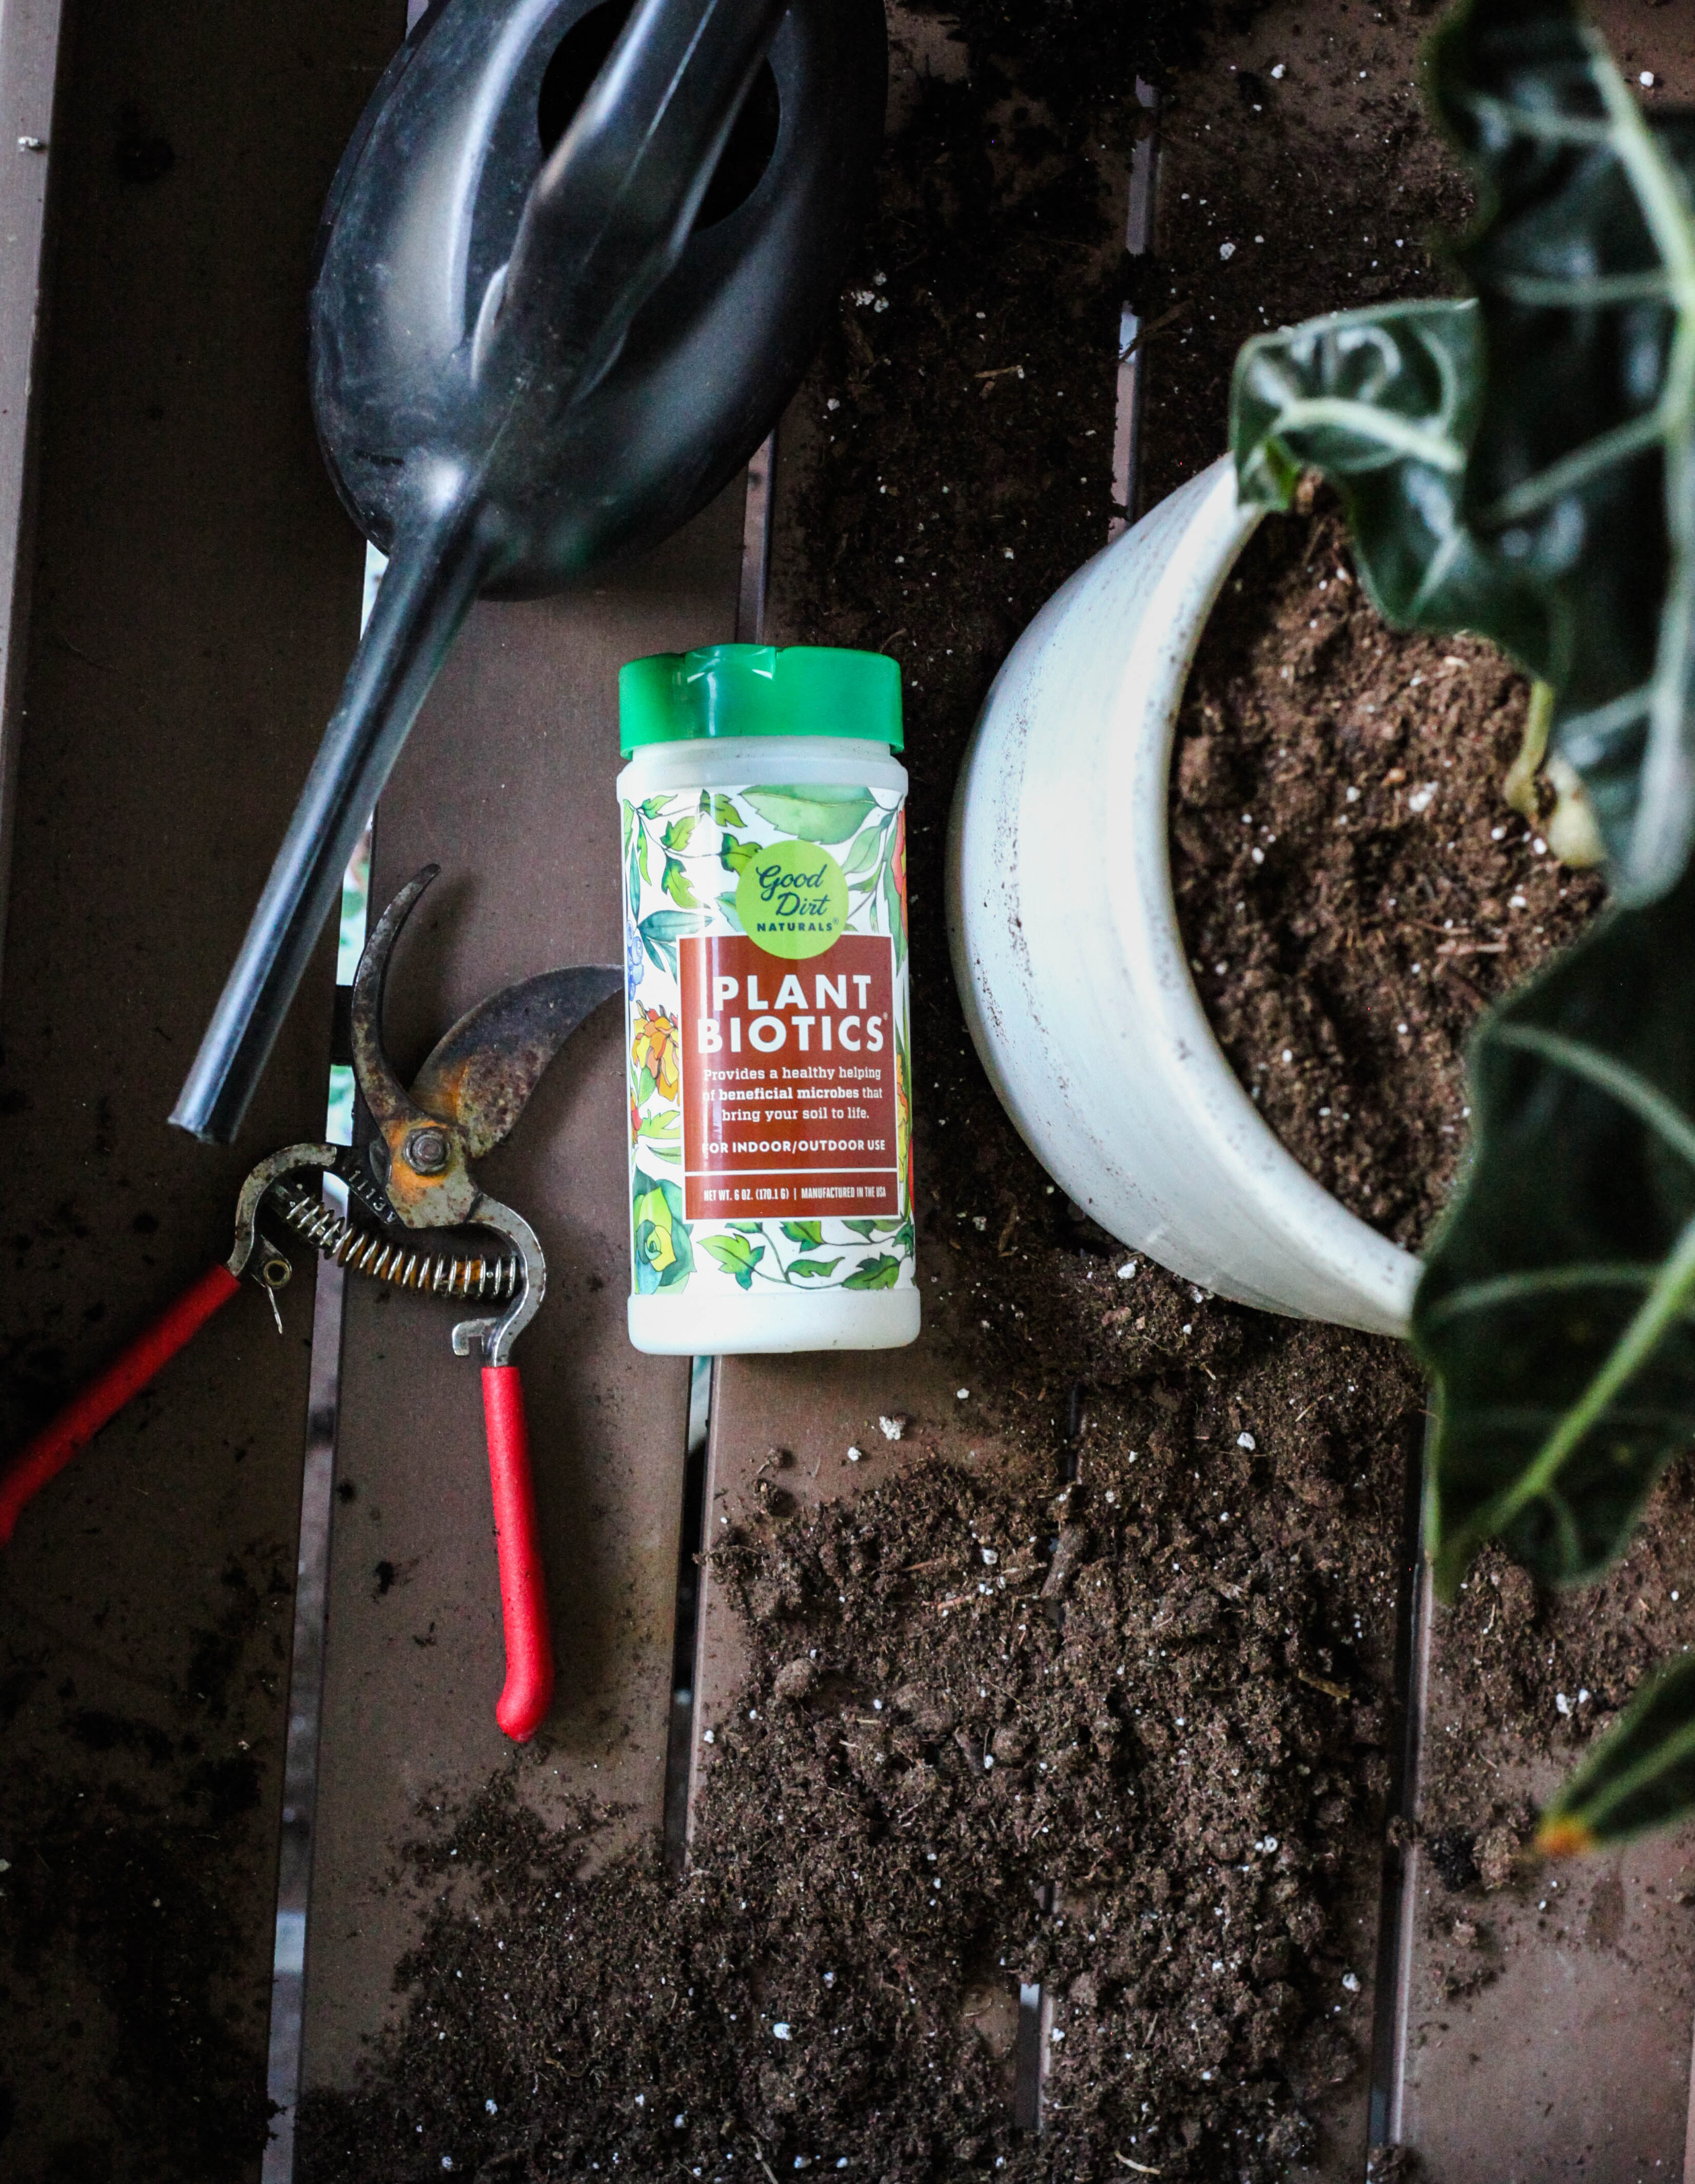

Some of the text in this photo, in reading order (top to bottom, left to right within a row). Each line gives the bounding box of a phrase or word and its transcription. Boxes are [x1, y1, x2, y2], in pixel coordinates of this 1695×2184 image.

[755, 863, 827, 901] Good
[775, 891, 831, 916] Dirt
[713, 974, 871, 1012] PLANT
[704, 1066, 882, 1081] Provides a healthy helping
[703, 1086, 883, 1101] of beneficial microbes that
[722, 1107, 870, 1123] bring your soil to life.
[702, 1139, 886, 1155] FOR INDOOR/OUTDOOR USE
[704, 1189, 717, 1202] NET
[718, 1189, 732, 1201] WT.
[734, 1188, 740, 1201] 6
[741, 1188, 754, 1201] OZ.
[755, 1188, 778, 1201] (170.1
[780, 1187, 789, 1200] G)
[801, 1187, 855, 1199] MANUFACTURED
[856, 1187, 864, 1198] IN
[865, 1186, 875, 1197] THE
[876, 1186, 886, 1197] USA
